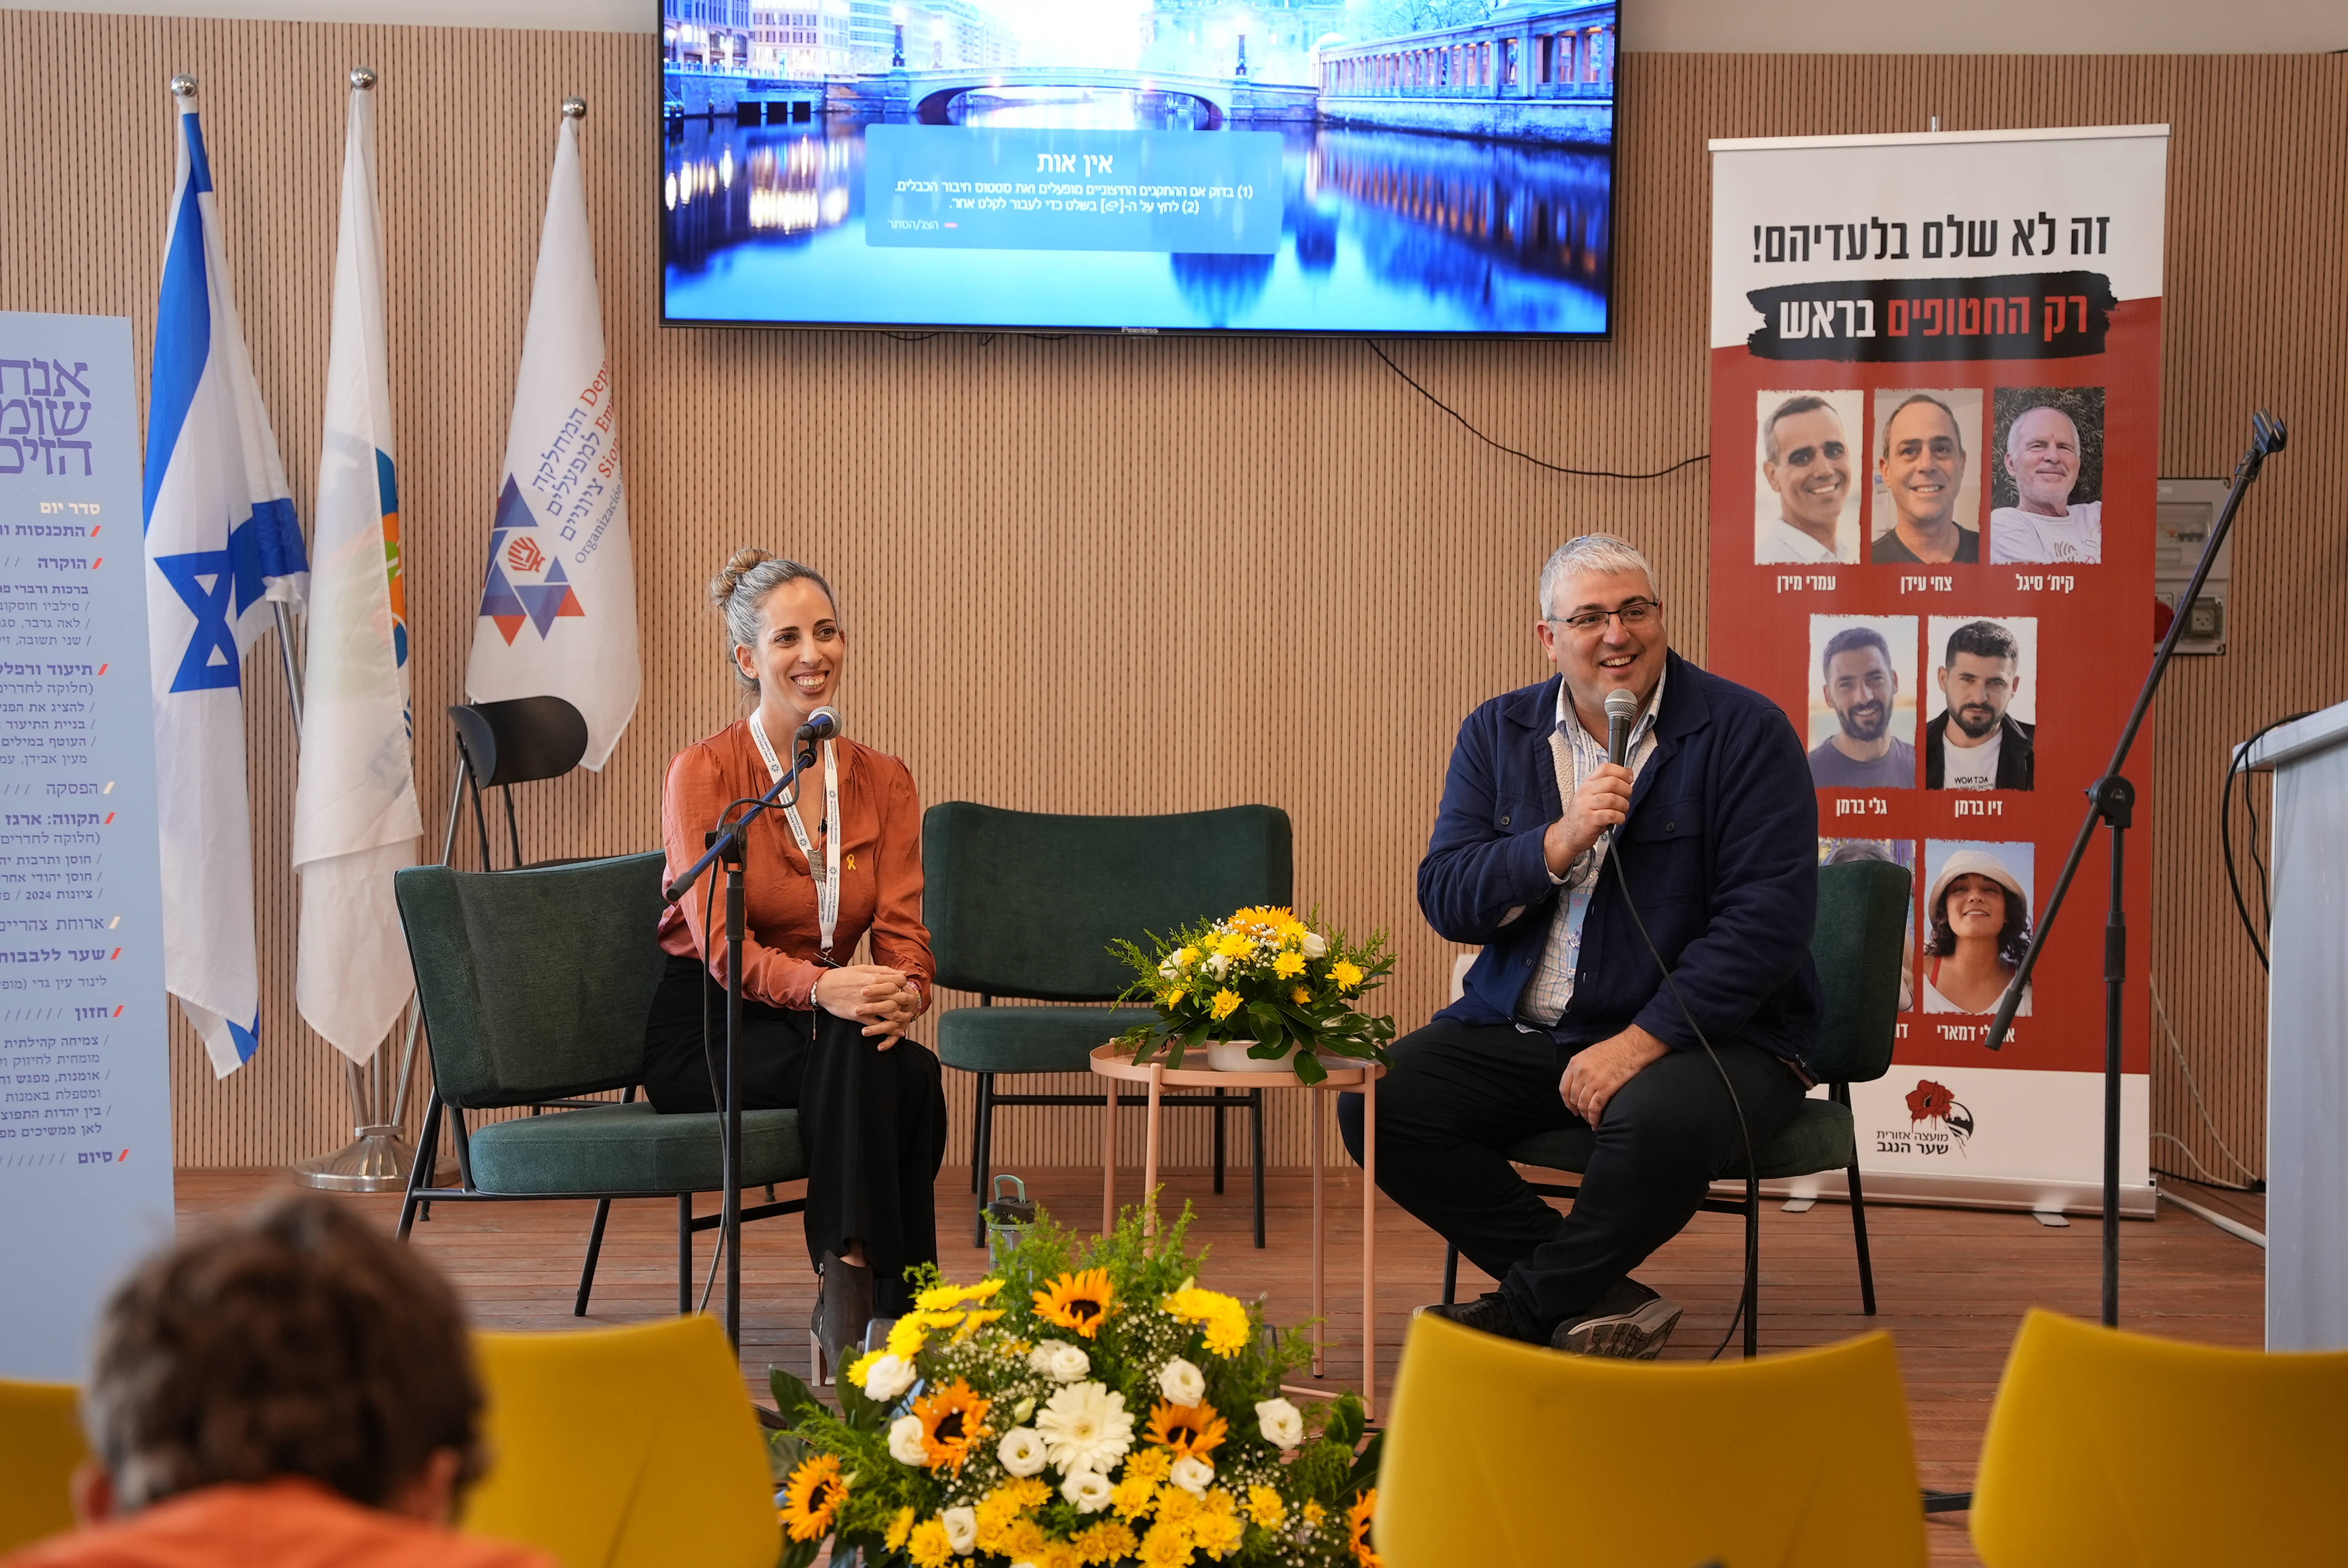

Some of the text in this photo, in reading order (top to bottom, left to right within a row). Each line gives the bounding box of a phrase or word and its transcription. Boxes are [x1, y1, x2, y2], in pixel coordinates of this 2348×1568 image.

[1036, 154, 1113, 177] אין אות
[941, 182, 971, 193] חיבור
[975, 183, 1012, 193] סטטוס
[1016, 183, 1036, 194] ואת
[1039, 182, 1083, 196] מופעלים
[1191, 186, 1206, 197] אם
[1209, 187, 1234, 199] בדוק
[1237, 184, 1253, 199] (1)
[978, 196, 1007, 211] לקלט
[1010, 198, 1042, 211] לעבור
[1046, 200, 1063, 211] כדי
[1065, 198, 1098, 212] בשלט
[1141, 199, 1155, 213] על
[1157, 199, 1180, 214] לחץ
[1182, 200, 1199, 215] (2)
[1752, 212, 2109, 263] זה לא שלם בלעדיהם!
[1779, 295, 2087, 342] רק החטופים בראש
[0, 358, 90, 398] אנח
[0, 397, 91, 436] שומ
[595, 395, 613, 434] Em
[532, 408, 587, 492] המחלקה
[546, 432, 599, 517] למפעלים
[40, 502, 100, 514] סדר יום
[559, 478, 603, 541] ציוניים
[15, 525, 85, 537] התכנסות
[38, 558, 86, 571] הוקרה
[1777, 575, 1836, 594] עמרי מירן
[1901, 575, 1953, 594] צחי עידן
[2015, 573, 2043, 592] סיגל
[15, 585, 48, 594] ודברי
[52, 586, 89, 594] ברכות
[43, 600, 79, 611] סילביו
[22, 619, 52, 628] גרבר,
[58, 617, 80, 628] לאה
[16, 637, 57, 646] תשובה,
[62, 637, 81, 645] שני
[0, 662, 92, 676] תיעוד ורפל
[47, 681, 93, 696] (חלוקה
[29, 704, 46, 712] את
[52, 702, 84, 712] להציג
[6, 721, 85, 730] בניית התיעוד
[2, 736, 86, 749] העוטף במילים
[21, 755, 56, 766] אבידן,
[62, 755, 87, 766] מעין
[47, 783, 97, 798] הפסקה
[1836, 797, 1887, 817] גלי ברמן
[1955, 799, 2002, 818] זיו ברמן
[5, 814, 99, 827] תקווה: ארגז
[54, 831, 100, 846] (חלוקה
[17, 856, 60, 865] ותרבות
[65, 855, 91, 866] חוסן
[0, 873, 92, 884] חוסן יהודי אחר
[26, 891, 51, 900] 2024
[56, 890, 92, 899] ציונות
[56, 919, 104, 930] ארוחת
[68, 950, 105, 962] שער
[0, 975, 107, 990] לינור עין גדי (מופ
[75, 1007, 107, 1021] חזון
[1894, 1023, 1909, 1039] דו
[1937, 1024, 1976, 1041] דמארי
[4, 1036, 99, 1049] צמיחה קהילתית
[13, 1054, 51, 1069] לחיזוק
[57, 1054, 100, 1064] מומחית
[16, 1074, 50, 1084] מפגש
[5, 1089, 101, 1102] ומטפלת באמנות
[45, 1108, 79, 1118] יהדות
[84, 1107, 101, 1118] בין
[22, 1126, 76, 1137] ממשיכים
[81, 1123, 102, 1136] לאן
[1876, 1131, 1948, 1142] מועצה אזורית
[1876, 1142, 1948, 1155] שער הנגב
[78, 1152, 112, 1164] סיום
